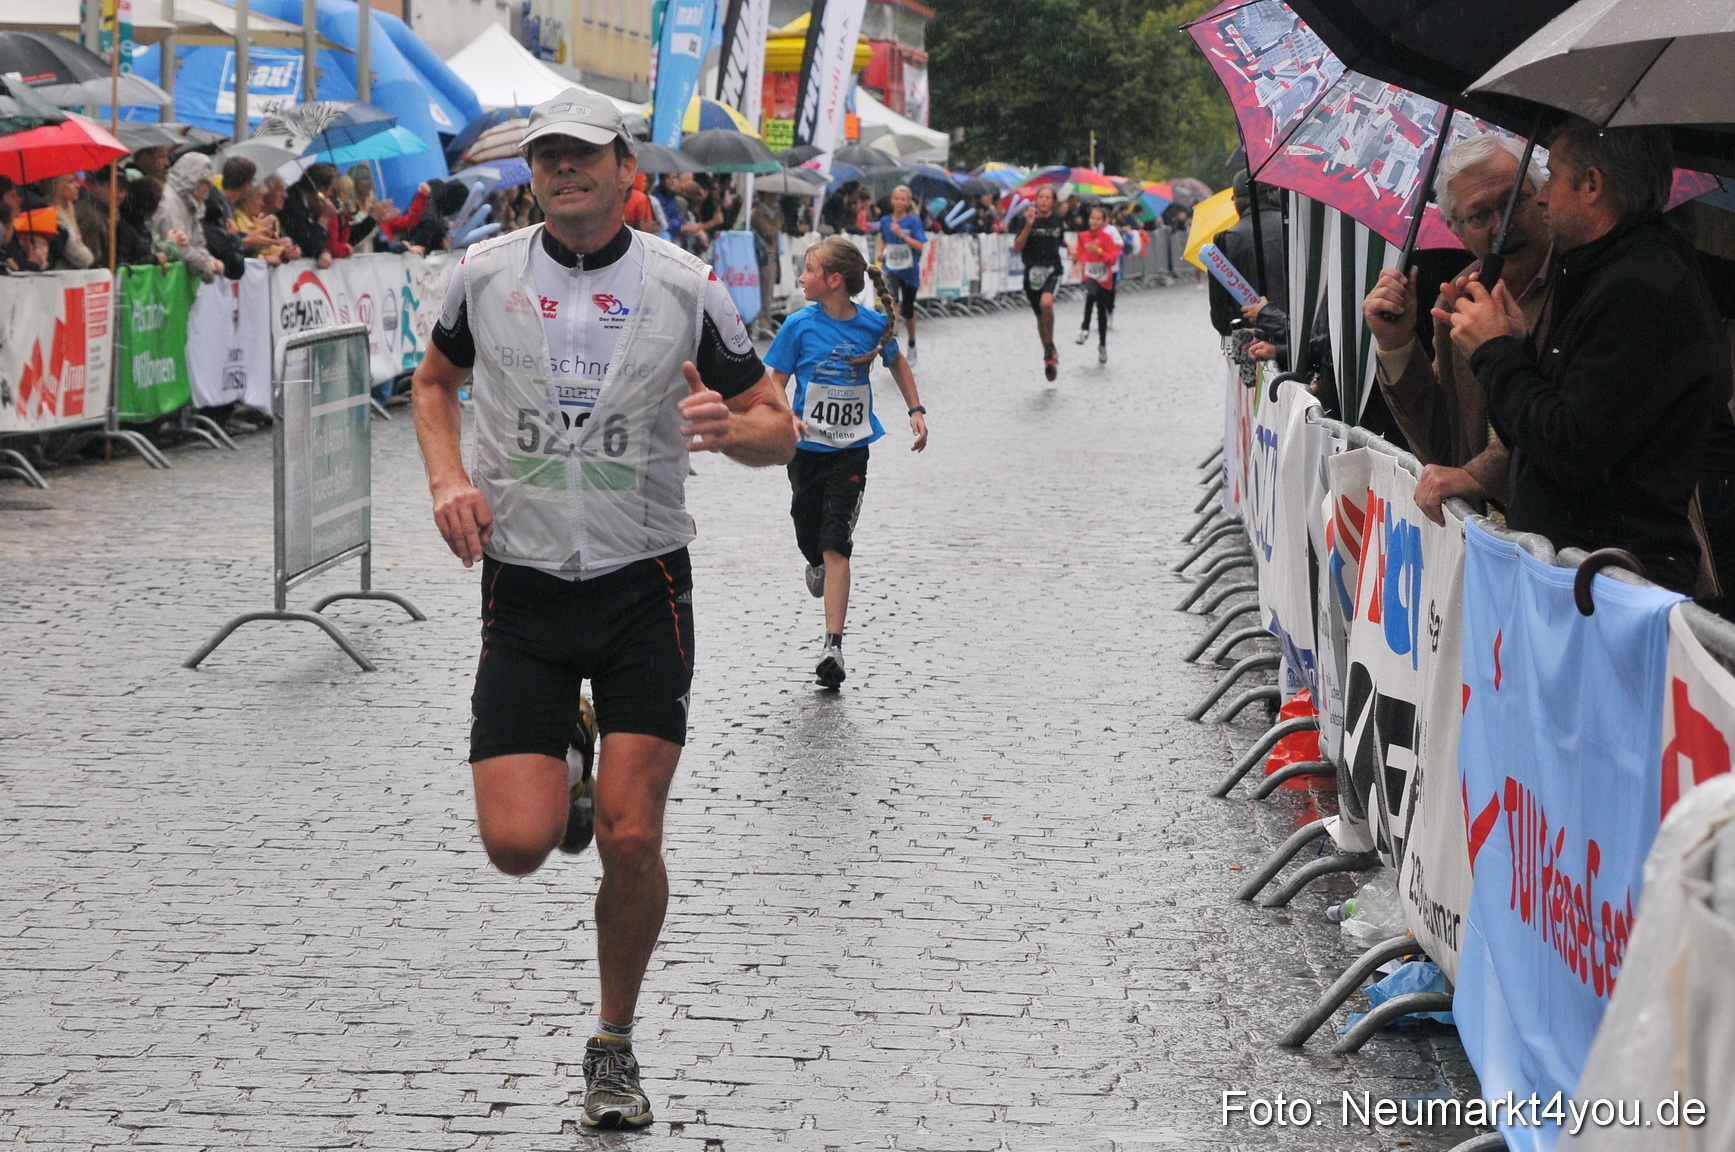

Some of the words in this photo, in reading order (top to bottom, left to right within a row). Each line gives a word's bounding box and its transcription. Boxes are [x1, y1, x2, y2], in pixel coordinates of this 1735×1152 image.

[1208, 251, 1261, 304] eiseCenter
[517, 408, 629, 458] 5226
[810, 400, 864, 427] 4083
[819, 429, 855, 440] Marlene
[1503, 776, 1537, 932] TUI
